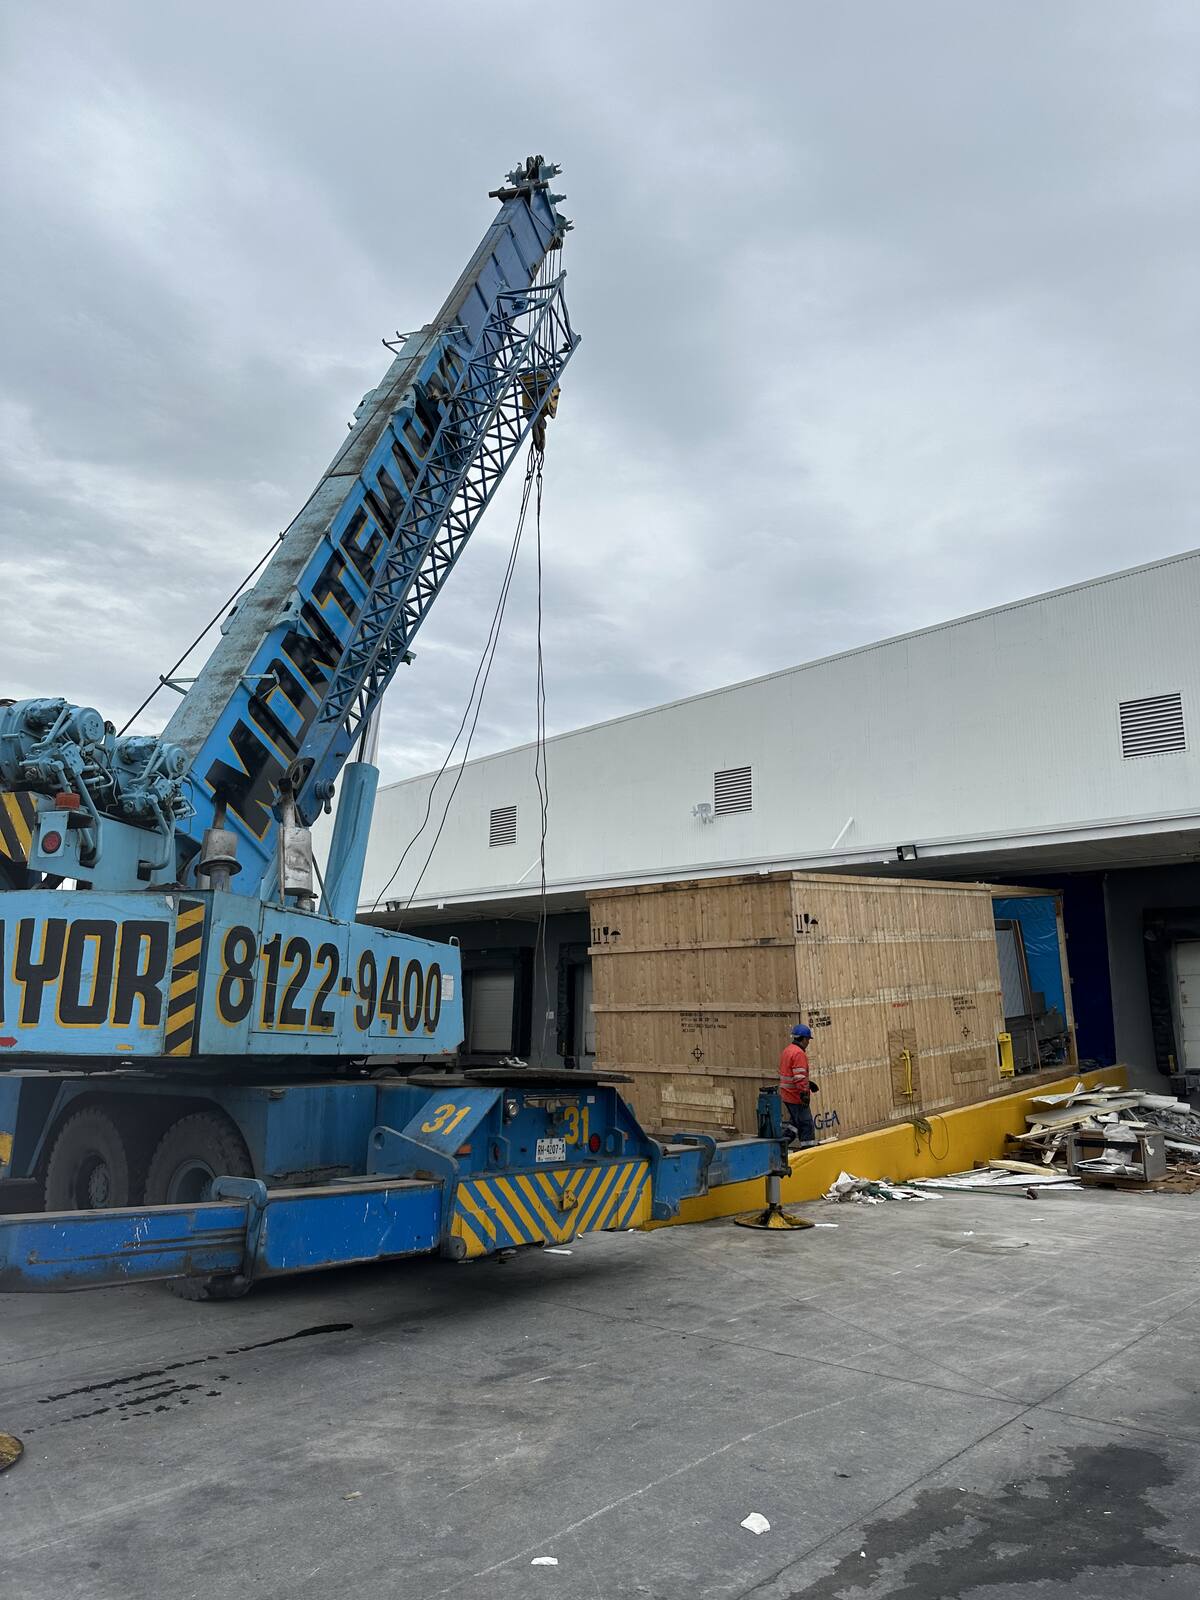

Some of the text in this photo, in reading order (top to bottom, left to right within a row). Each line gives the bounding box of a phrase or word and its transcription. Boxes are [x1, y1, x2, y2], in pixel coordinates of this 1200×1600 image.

[204, 344, 470, 842] MONTEMAYR
[0, 918, 170, 1029] YOR
[216, 924, 442, 1036] 8122-9400
[421, 1103, 471, 1135] 31
[563, 1106, 590, 1145] 31
[813, 1110, 841, 1130] GEA
